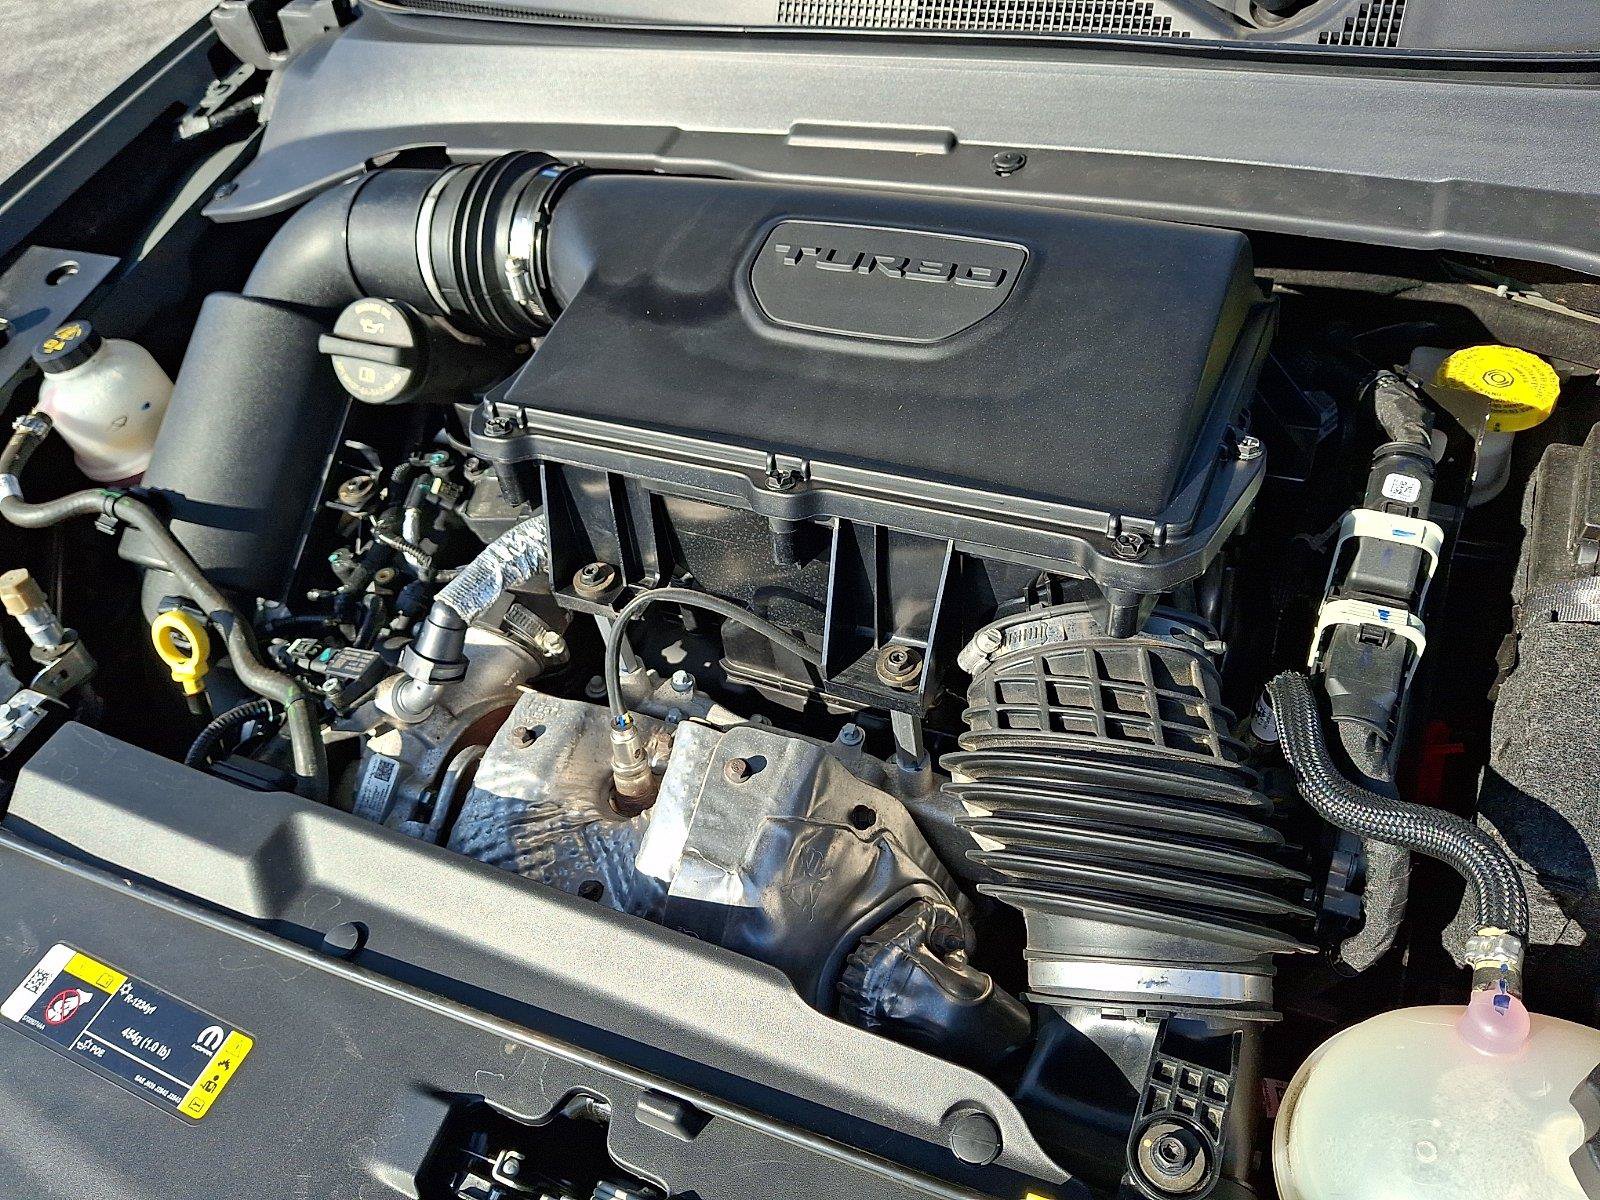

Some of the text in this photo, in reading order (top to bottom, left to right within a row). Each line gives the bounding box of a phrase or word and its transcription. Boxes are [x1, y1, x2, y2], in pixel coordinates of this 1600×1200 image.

[774, 243, 1008, 289] TURBO
[89, 1044, 106, 1058] POE
[121, 1027, 172, 1061] 454g (1.0 lb)
